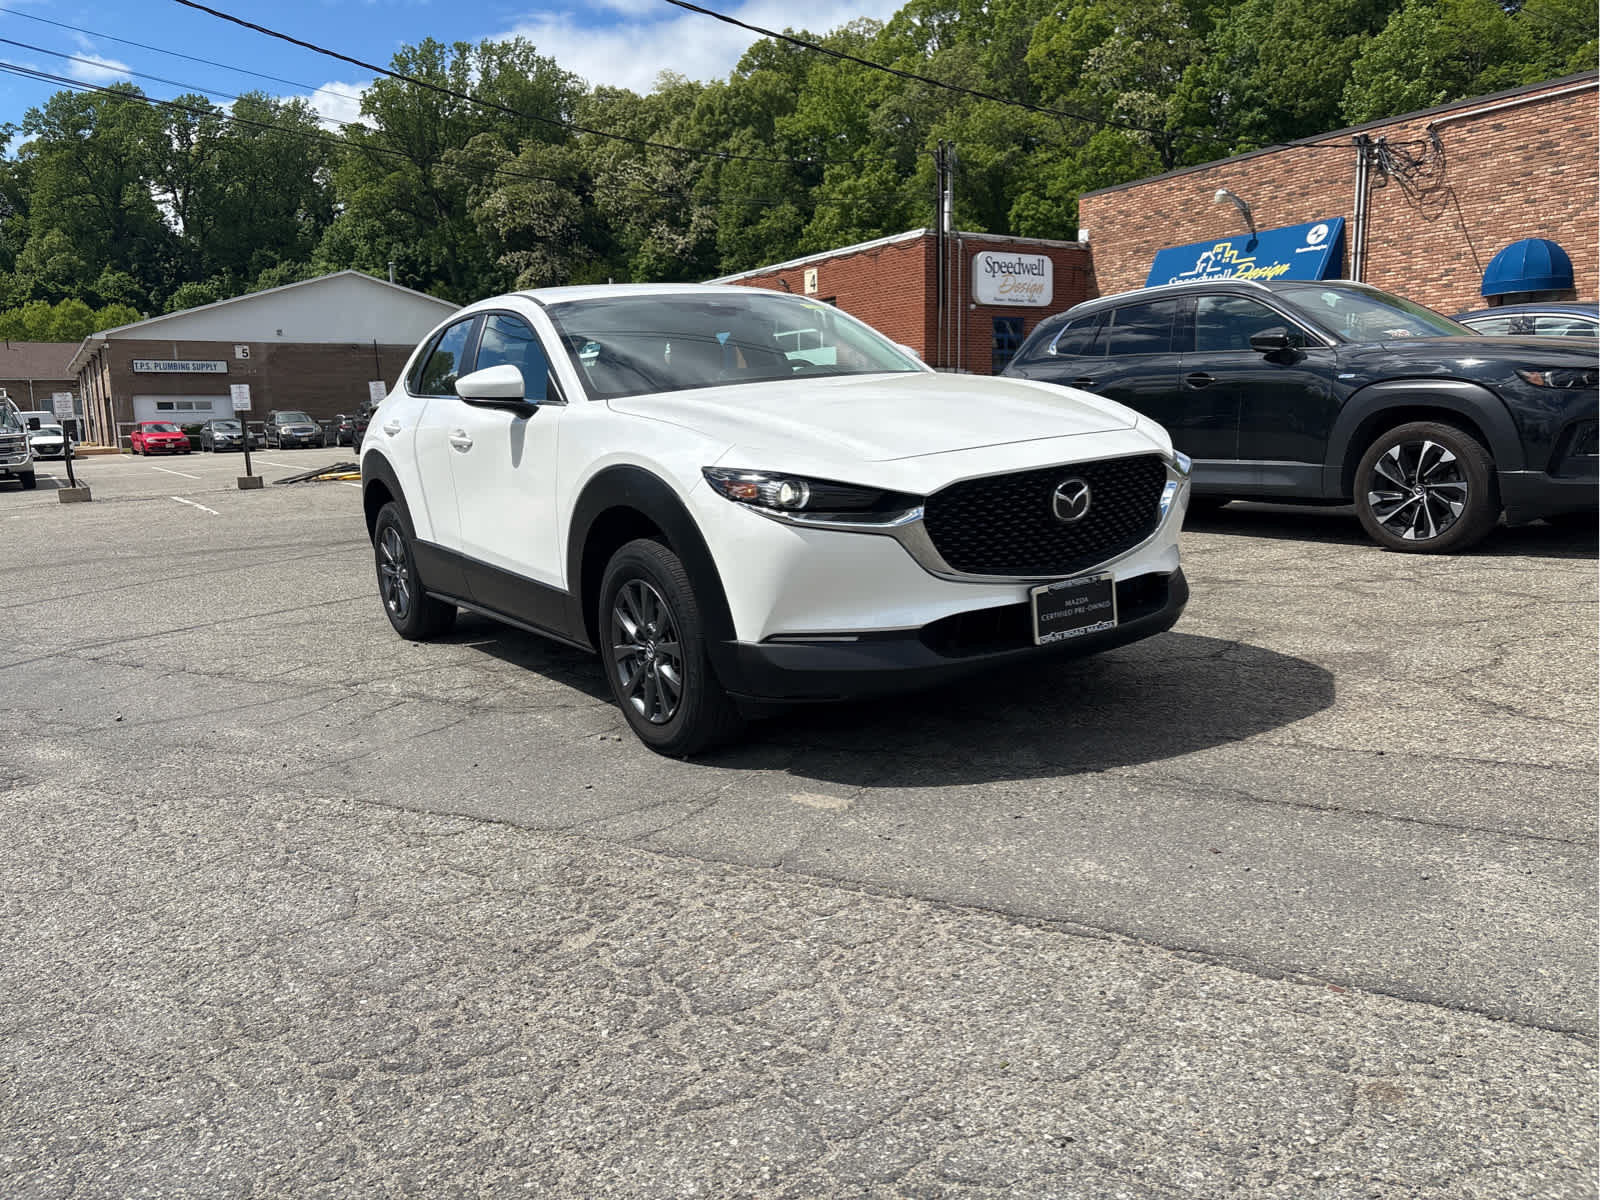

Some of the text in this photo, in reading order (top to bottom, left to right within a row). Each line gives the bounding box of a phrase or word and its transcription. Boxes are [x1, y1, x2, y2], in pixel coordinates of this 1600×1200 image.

[984, 255, 1045, 278] Speedwell
[1231, 261, 1290, 281] Design
[810, 274, 816, 290] 4
[998, 273, 1044, 300] Design
[241, 348, 249, 358] 5
[134, 362, 217, 372] T.P.S. PLUMBING SUPPLY
[1064, 597, 1088, 607] MAZDA
[1041, 601, 1111, 621] CERTIFIED PRE-OWNED
[1063, 629, 1085, 638] ROAD
